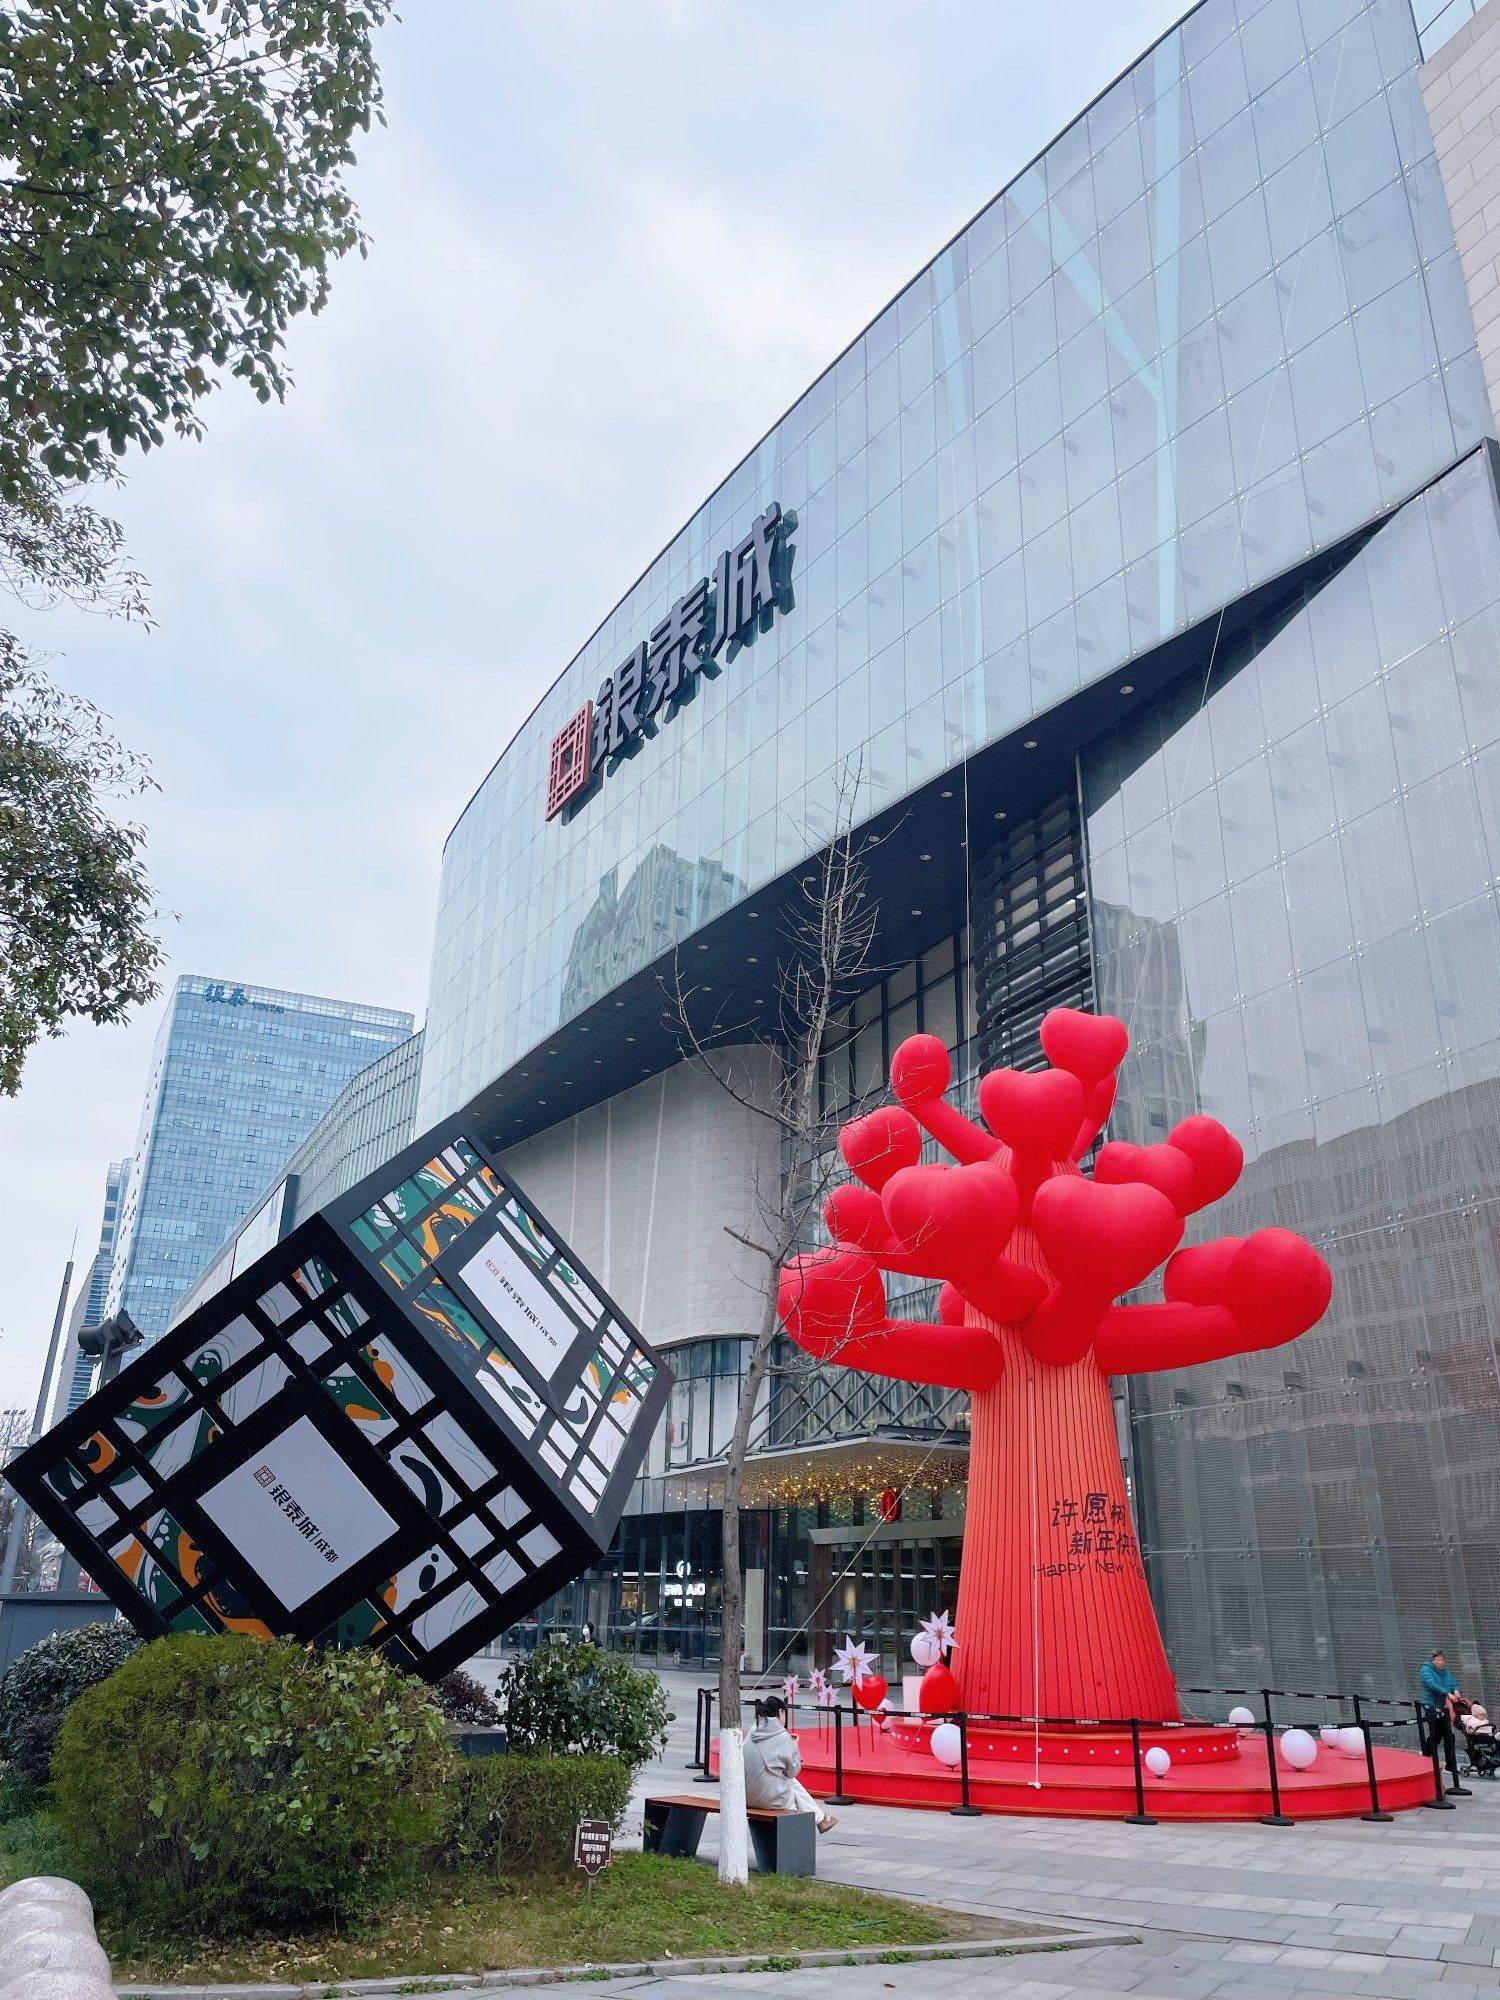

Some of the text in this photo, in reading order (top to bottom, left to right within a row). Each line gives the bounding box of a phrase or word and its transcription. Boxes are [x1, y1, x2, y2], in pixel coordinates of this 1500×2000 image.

[591, 501, 786, 773] 银泰城
[204, 983, 248, 1007] 银泰
[1052, 1493, 1126, 1526] 许愿树
[1033, 1561, 1085, 1579] Happy
[1096, 1559, 1124, 1574] New
